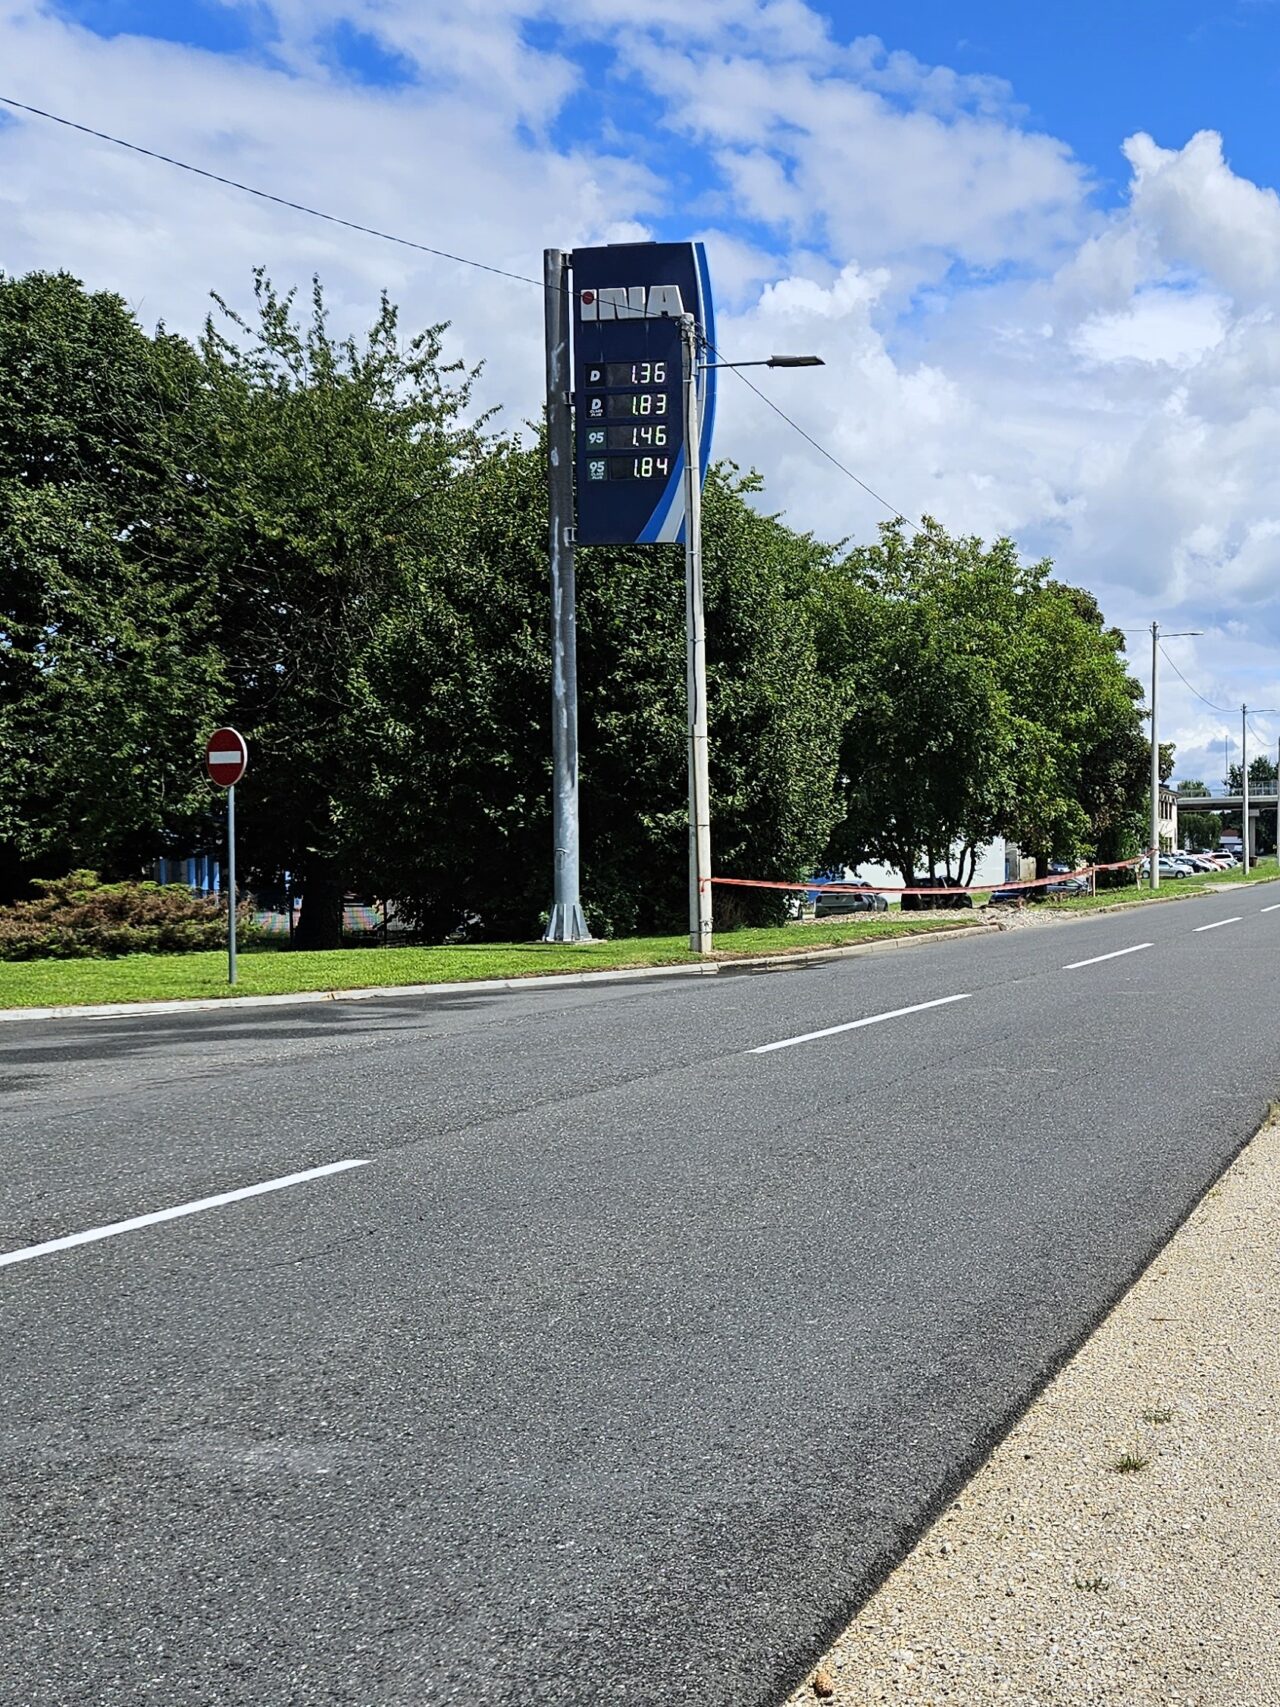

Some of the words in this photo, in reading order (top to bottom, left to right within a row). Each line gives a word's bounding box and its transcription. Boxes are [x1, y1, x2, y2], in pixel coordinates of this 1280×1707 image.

[580, 284, 685, 321] INA
[589, 370, 601, 382] D
[631, 362, 666, 384] 1.36
[591, 398, 602, 410] D
[632, 394, 667, 415] 1.83
[588, 431, 605, 444] 95
[632, 425, 667, 446] 1.46
[589, 461, 605, 473] 95
[633, 457, 668, 478] 1.84
